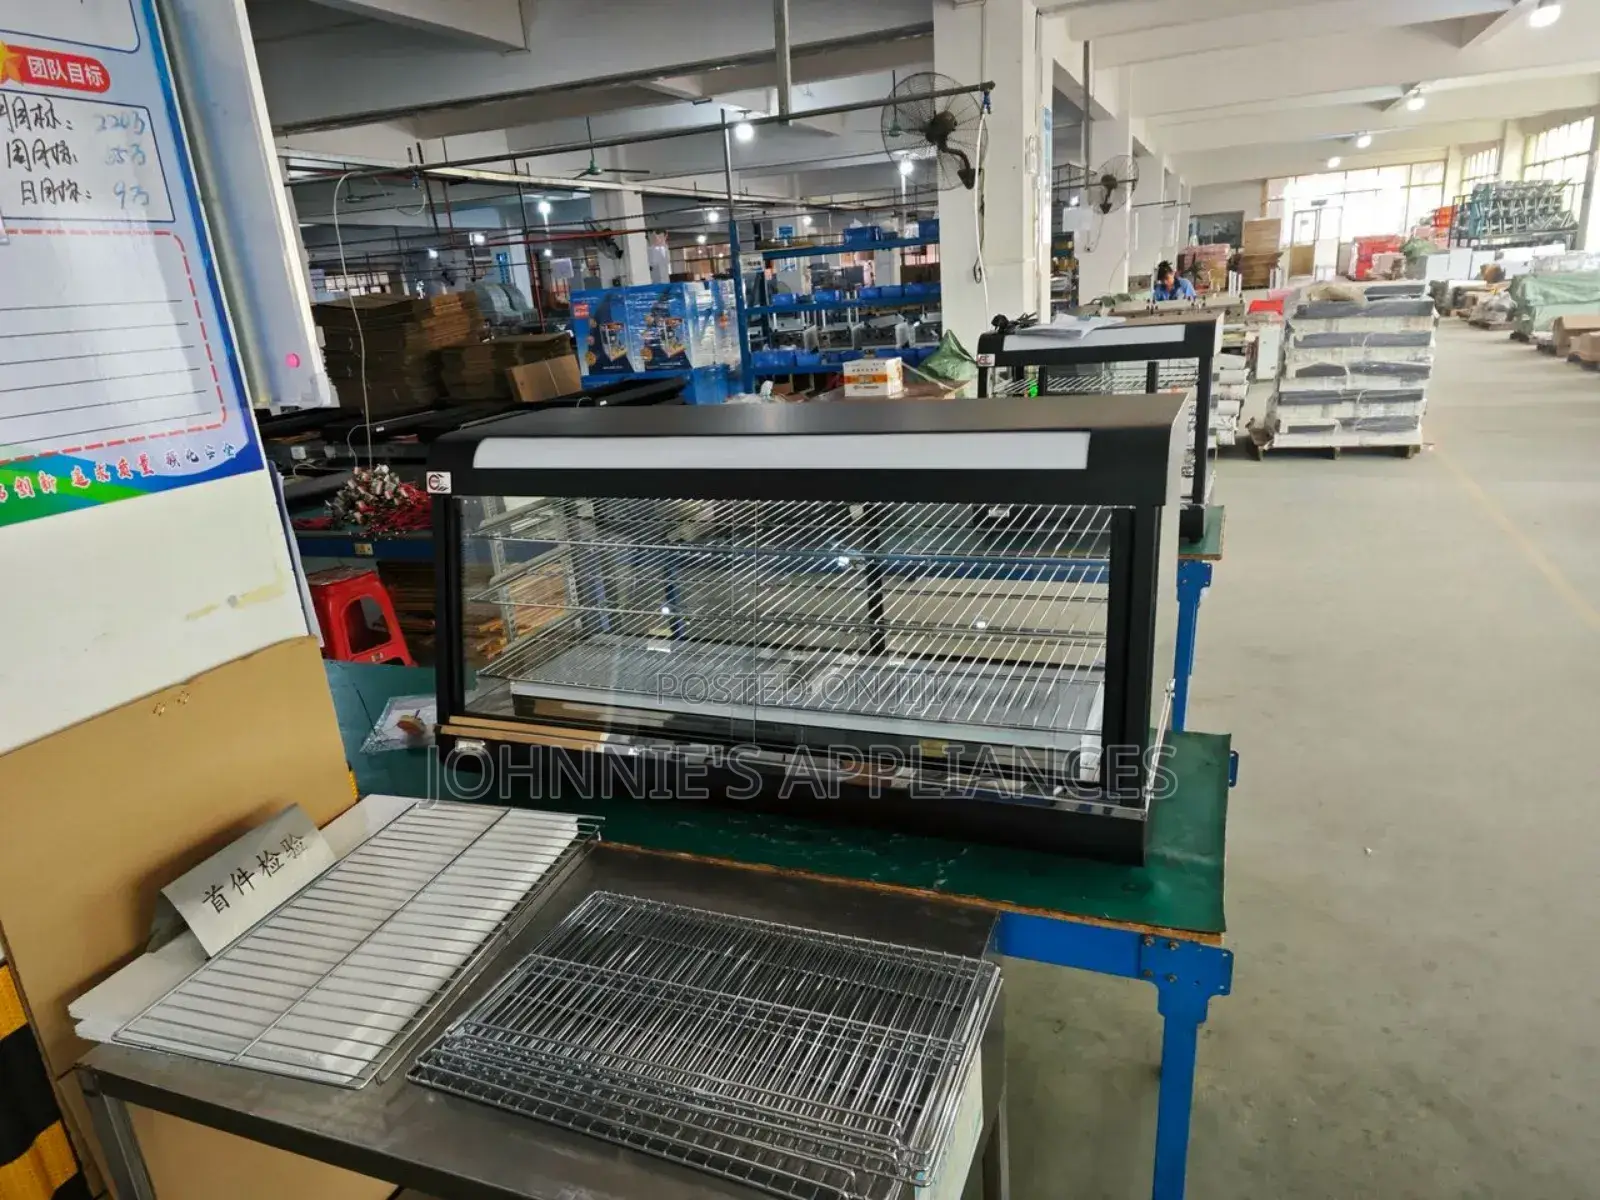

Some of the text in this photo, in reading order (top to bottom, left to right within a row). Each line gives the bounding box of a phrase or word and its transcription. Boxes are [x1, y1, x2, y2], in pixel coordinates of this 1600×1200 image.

[27, 55, 105, 87] 团队目标
[202, 833, 309, 914] 首件检验
